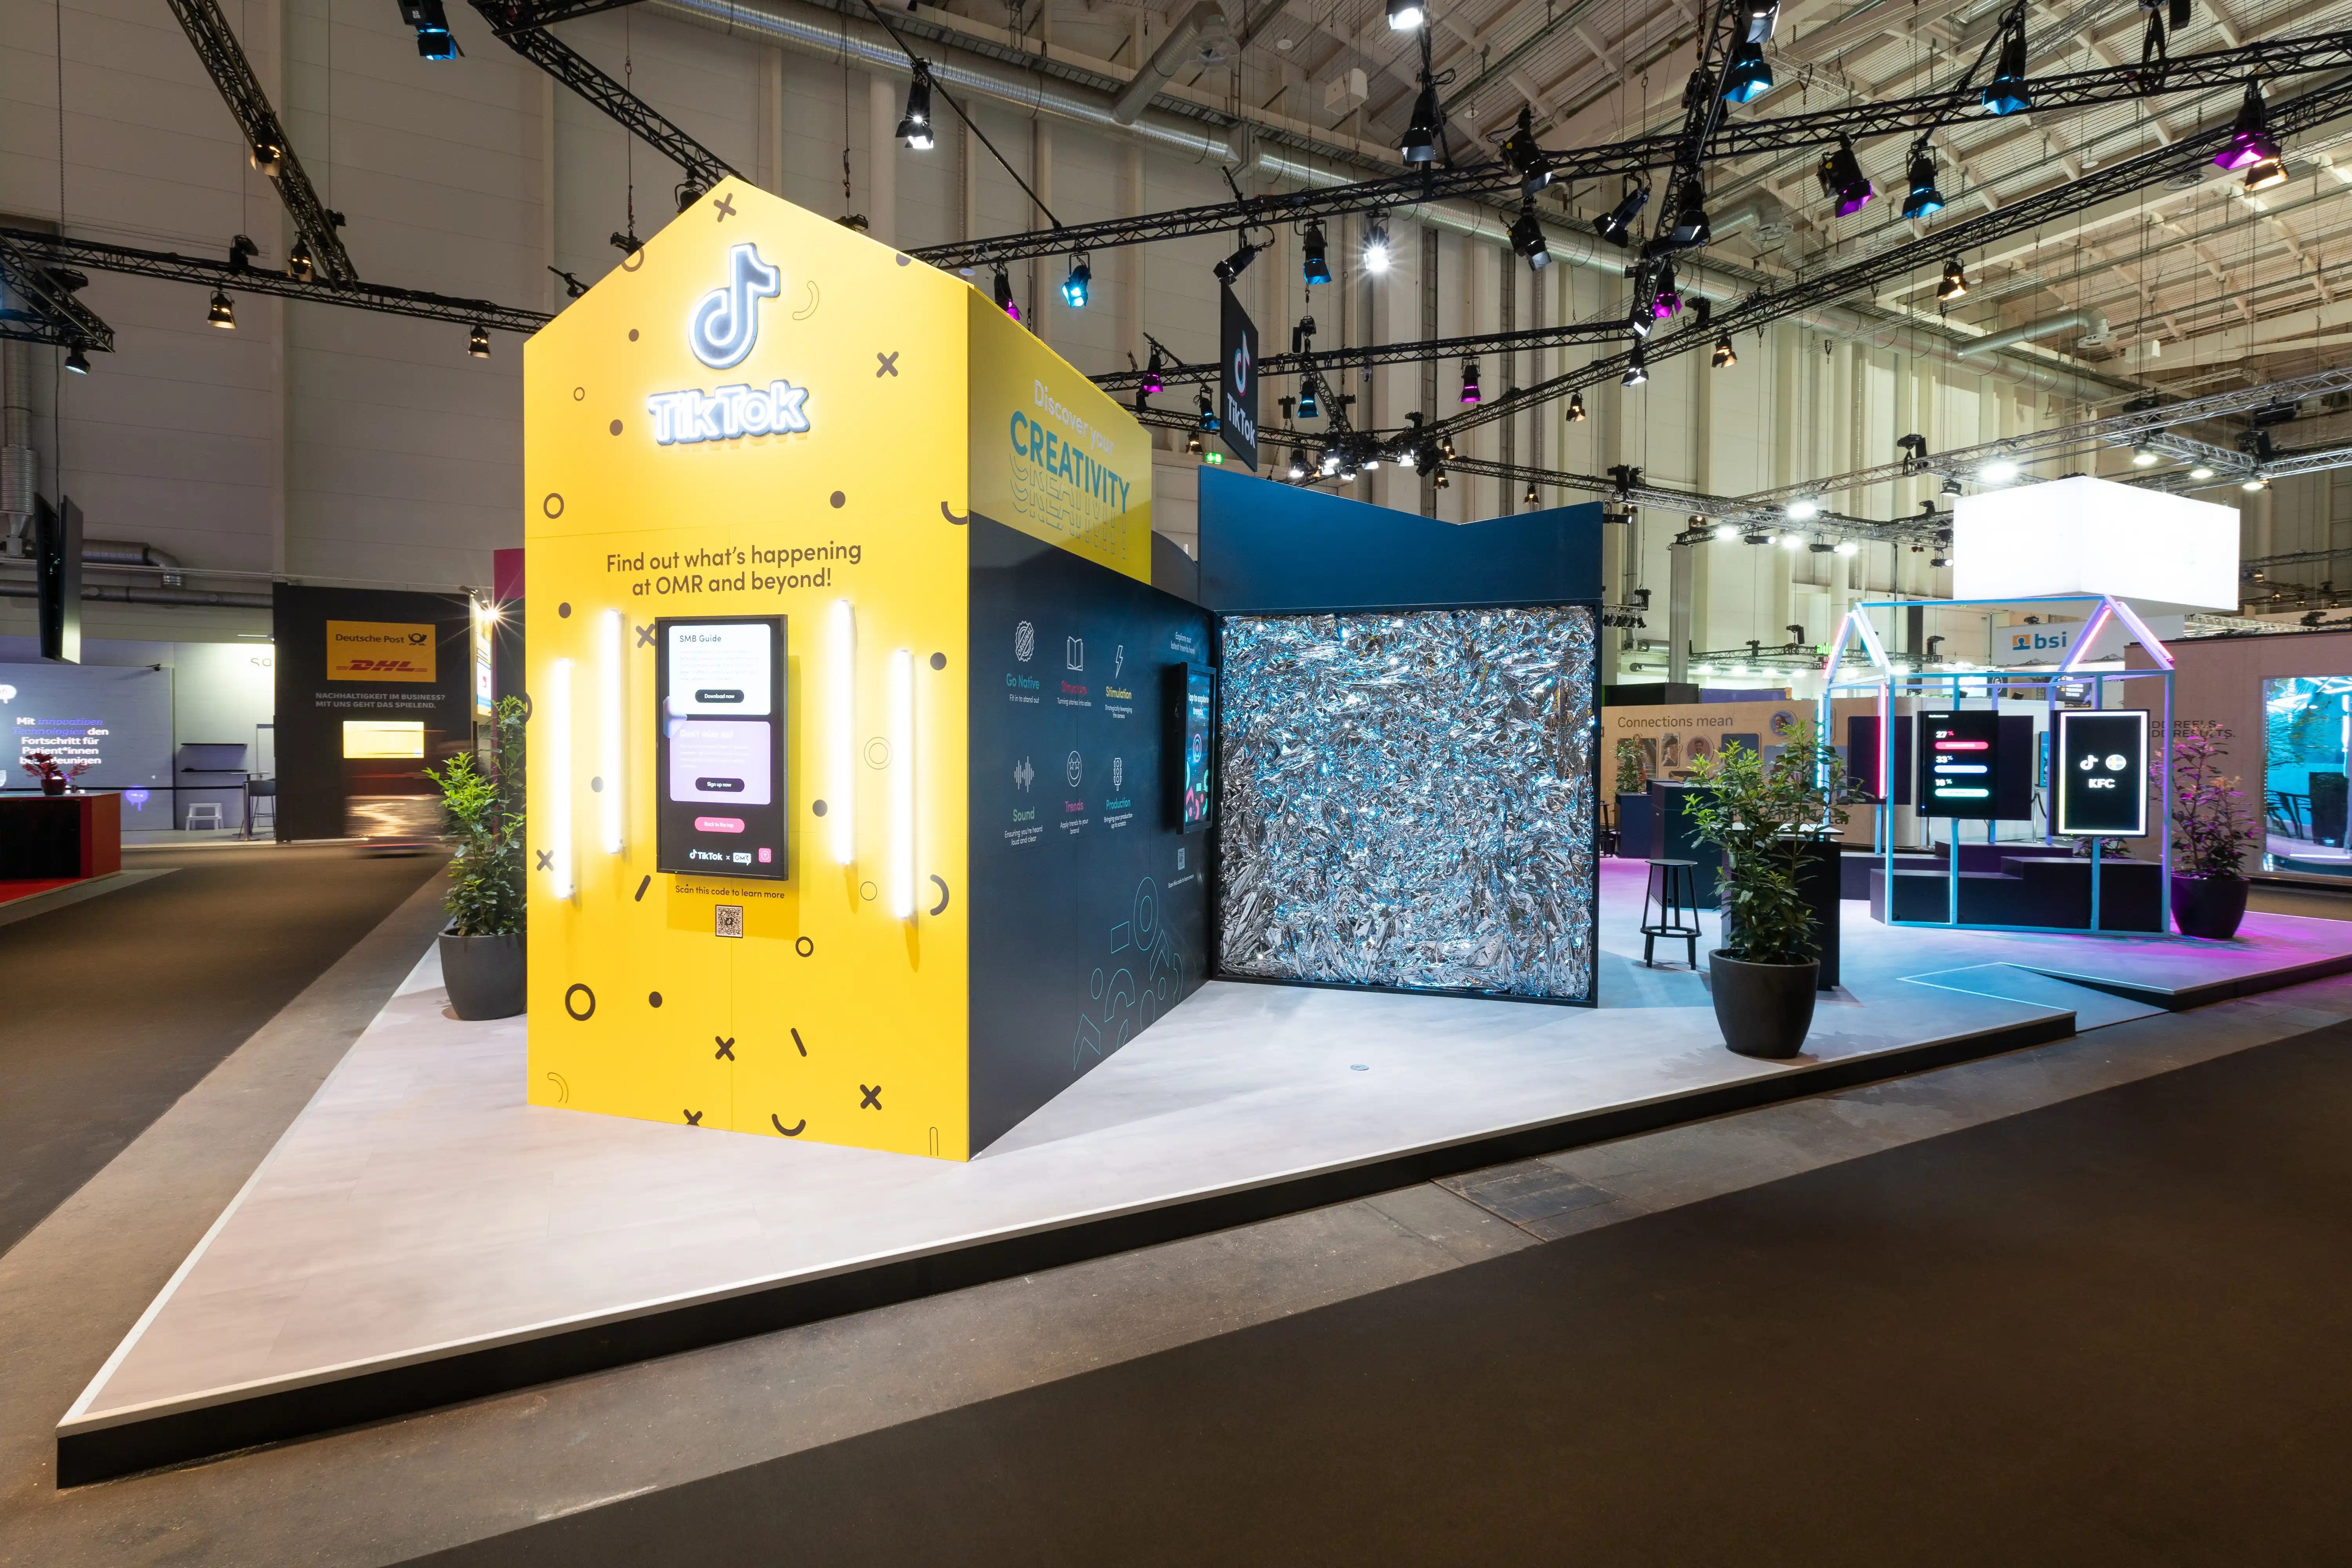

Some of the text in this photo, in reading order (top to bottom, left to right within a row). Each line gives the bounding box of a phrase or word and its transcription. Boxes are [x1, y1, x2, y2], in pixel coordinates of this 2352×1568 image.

[648, 380, 810, 445] TikTok
[1034, 379, 1114, 456] Discover your
[1227, 392, 1255, 449] TikTok
[1010, 410, 1130, 514] CREATIVITY
[607, 552, 644, 572] Find
[650, 552, 679, 570] out
[751, 541, 862, 568] happening
[632, 568, 831, 595] at OMR and beyond!
[336, 634, 381, 642] Deutsche
[1018, 627, 1033, 655] ORIGINAL
[1176, 632, 1186, 642] Explore
[2034, 632, 2067, 649] bsi
[1171, 641, 1179, 651] latest
[1180, 644, 1189, 653] trends
[349, 660, 416, 672] DHL
[1006, 673, 1040, 690] Go Native
[1106, 686, 1132, 699] Stimulation
[1057, 697, 1068, 706] Turning
[1198, 695, 1209, 705] explore
[16, 717, 103, 726] Mit innovativen
[1618, 715, 1733, 728] Connections mean
[12, 727, 85, 737] Technologien
[21, 737, 99, 745] Fortschritt für
[2089, 779, 2115, 788] KFC
[1065, 799, 1083, 812] Trends
[1106, 797, 1131, 810] Production
[1013, 806, 1034, 822] Sound
[1120, 812, 1133, 821] production
[1005, 825, 1043, 838] Ensuring you're heard
[1060, 821, 1069, 829] Apply
[698, 852, 723, 860] TikTok
[742, 889, 762, 897] learn
